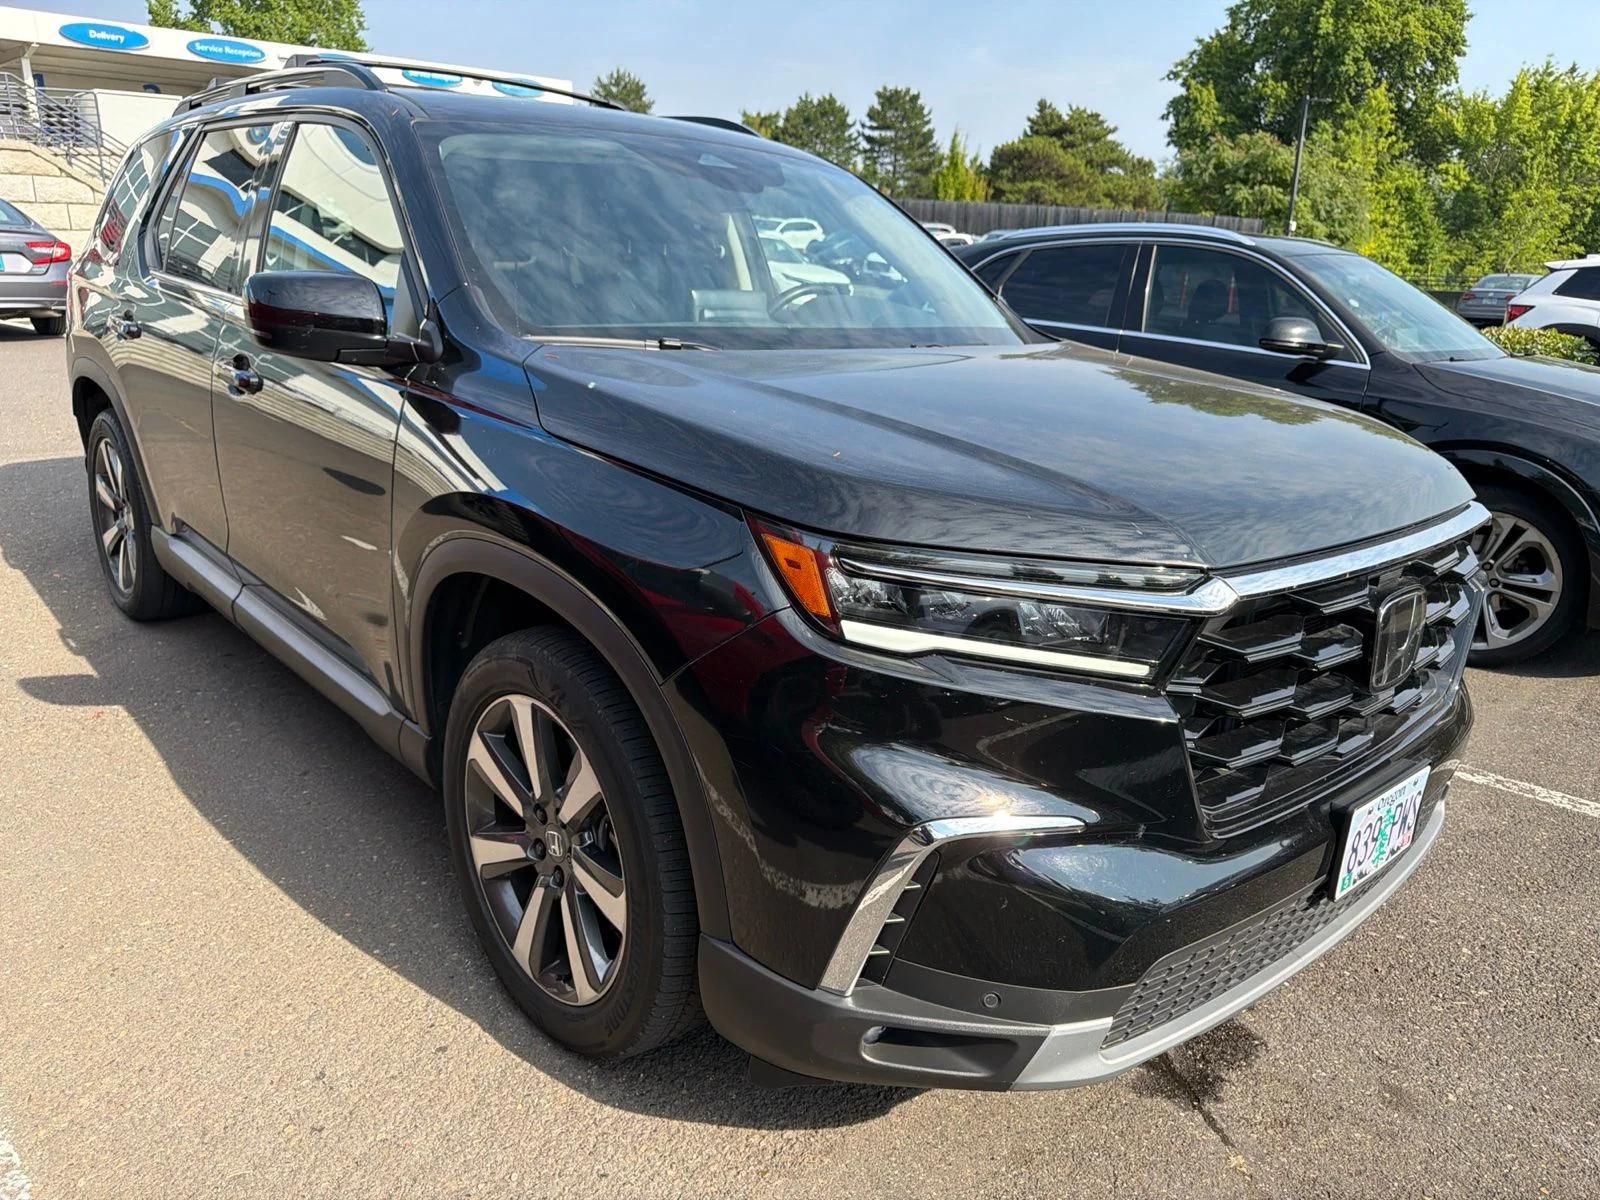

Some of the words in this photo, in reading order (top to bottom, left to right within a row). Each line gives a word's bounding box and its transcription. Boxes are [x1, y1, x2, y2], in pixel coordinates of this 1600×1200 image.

[88, 29, 125, 43] Delivery
[194, 42, 223, 54] Service
[224, 46, 261, 59] Reception
[1346, 816, 1383, 874] 839
